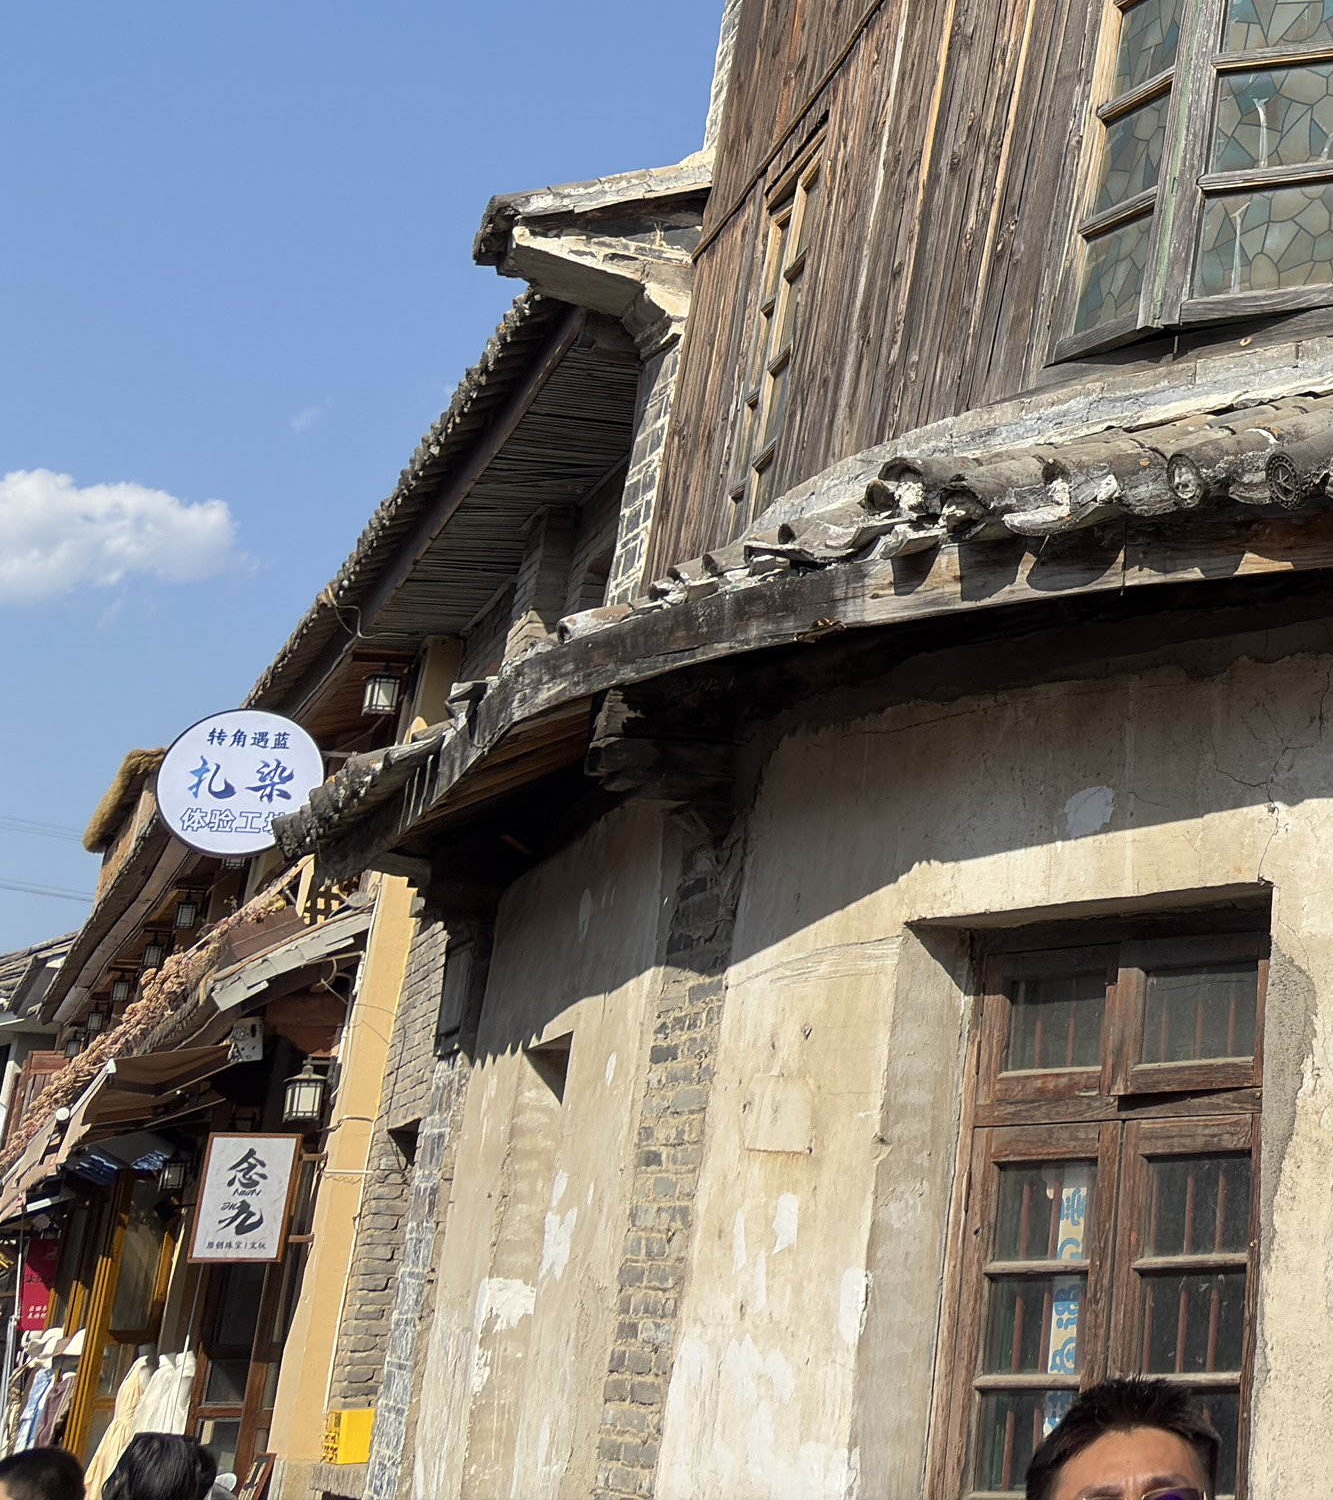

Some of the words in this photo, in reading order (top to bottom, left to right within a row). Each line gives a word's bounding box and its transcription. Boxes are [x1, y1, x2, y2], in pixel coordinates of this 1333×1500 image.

[207, 727, 291, 750] 转角遇蓝
[187, 755, 295, 804] 扎染
